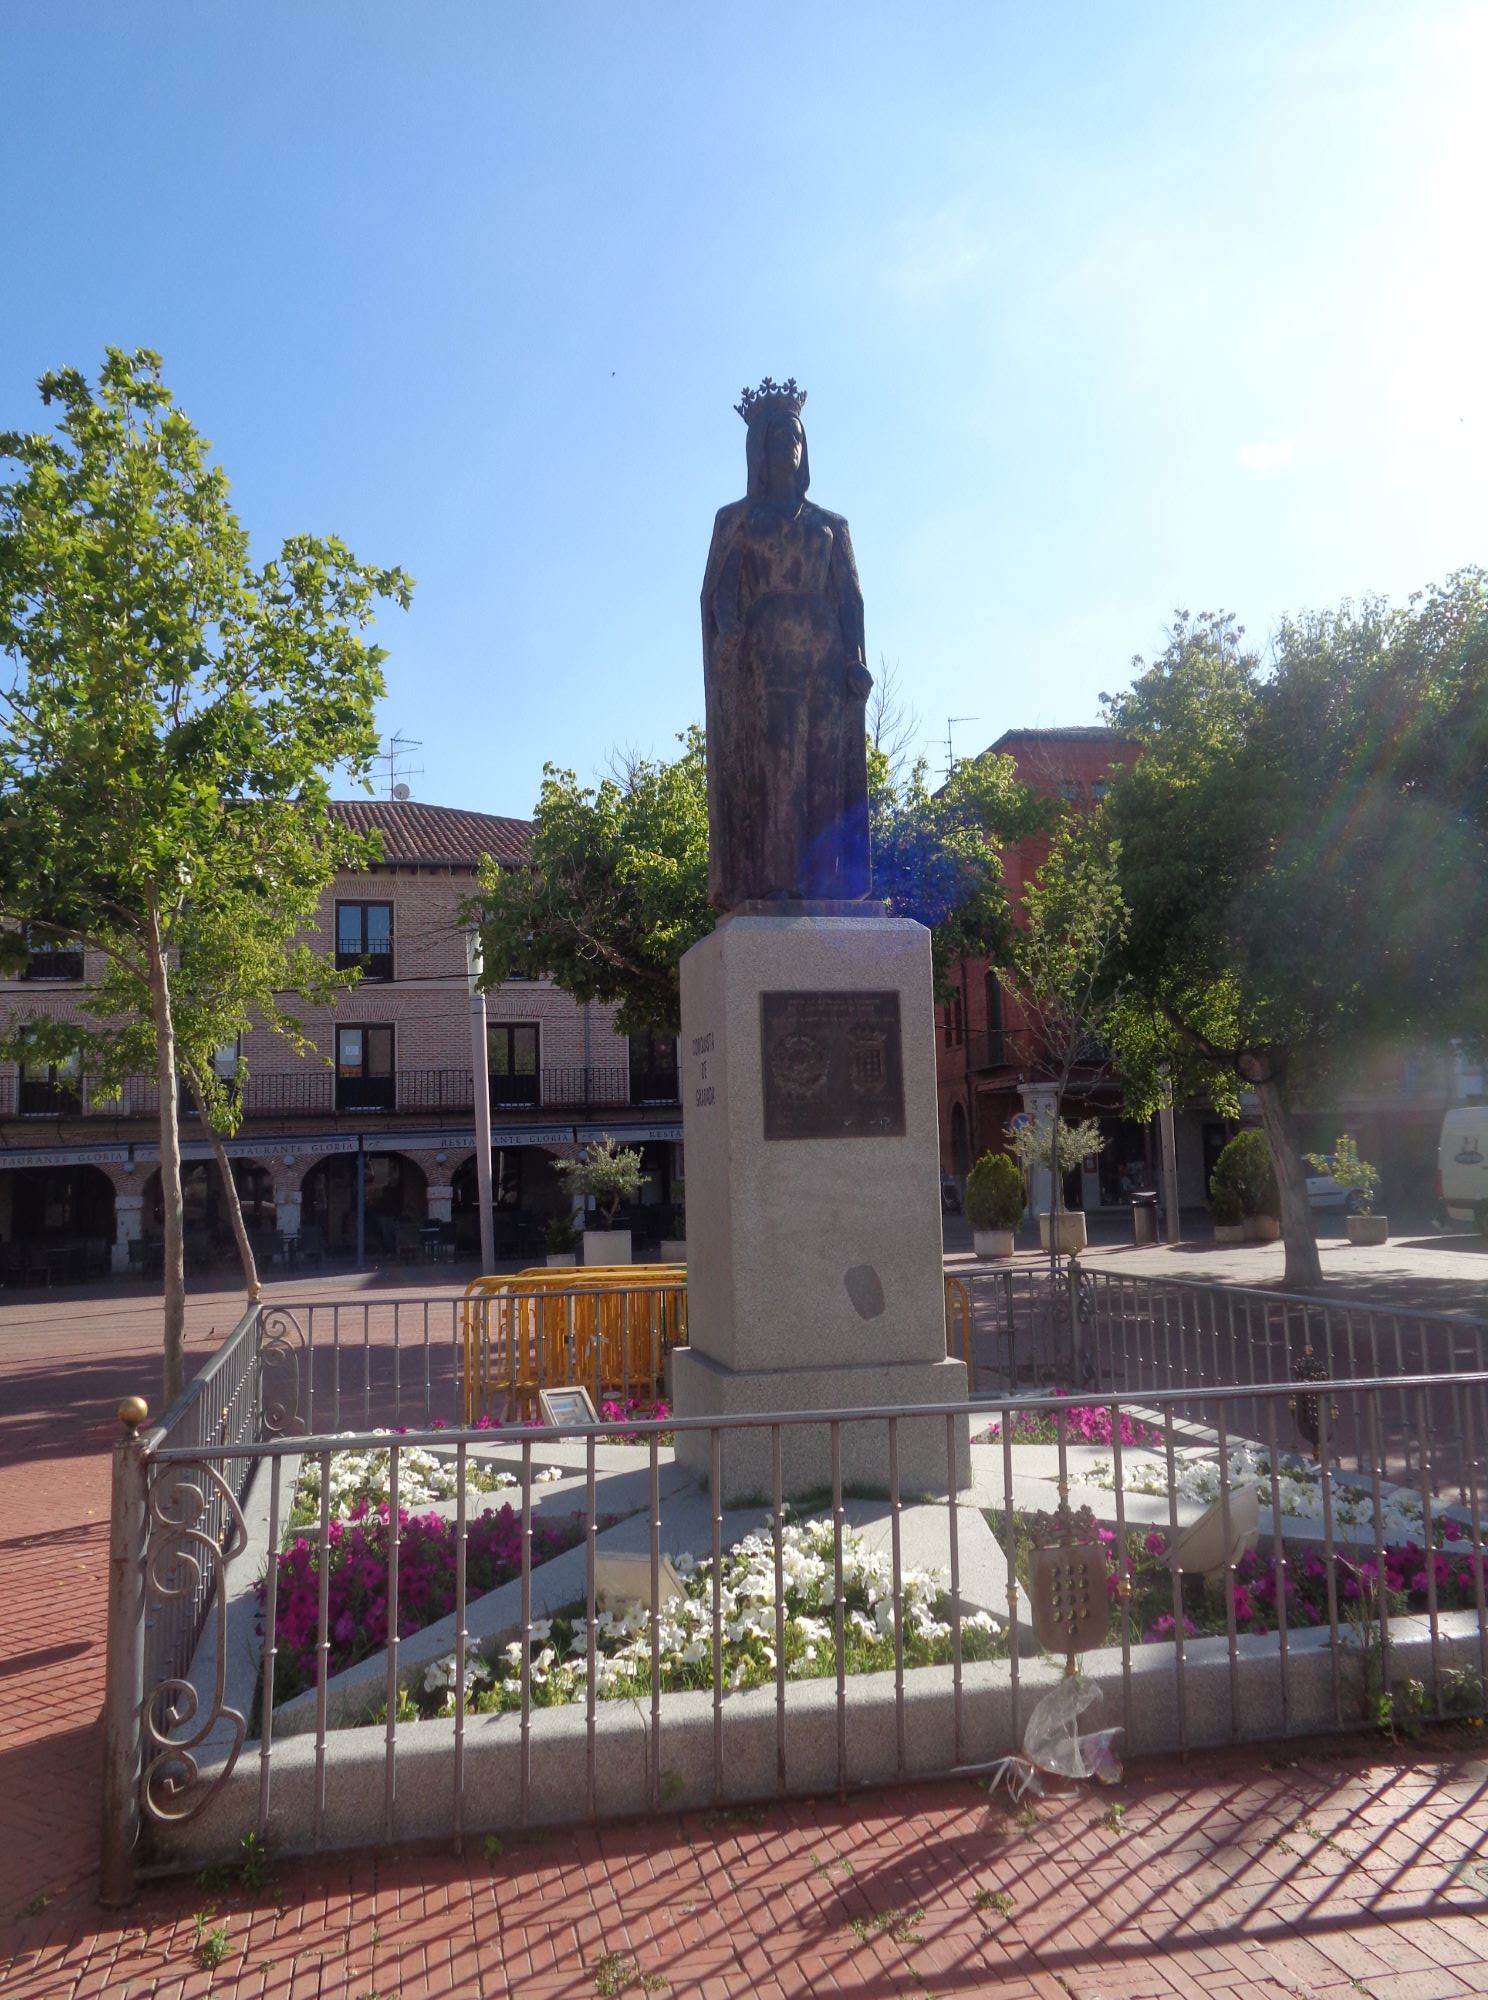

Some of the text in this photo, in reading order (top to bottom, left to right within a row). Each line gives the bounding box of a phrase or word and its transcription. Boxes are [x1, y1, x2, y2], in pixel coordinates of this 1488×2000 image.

[649, 1130, 682, 1138] RESTA
[441, 1134, 569, 1147] RESTAANTE GLORIA
[311, 1143, 353, 1152] GLORIA
[1, 1153, 122, 1167] TAURANTE GLORIA
